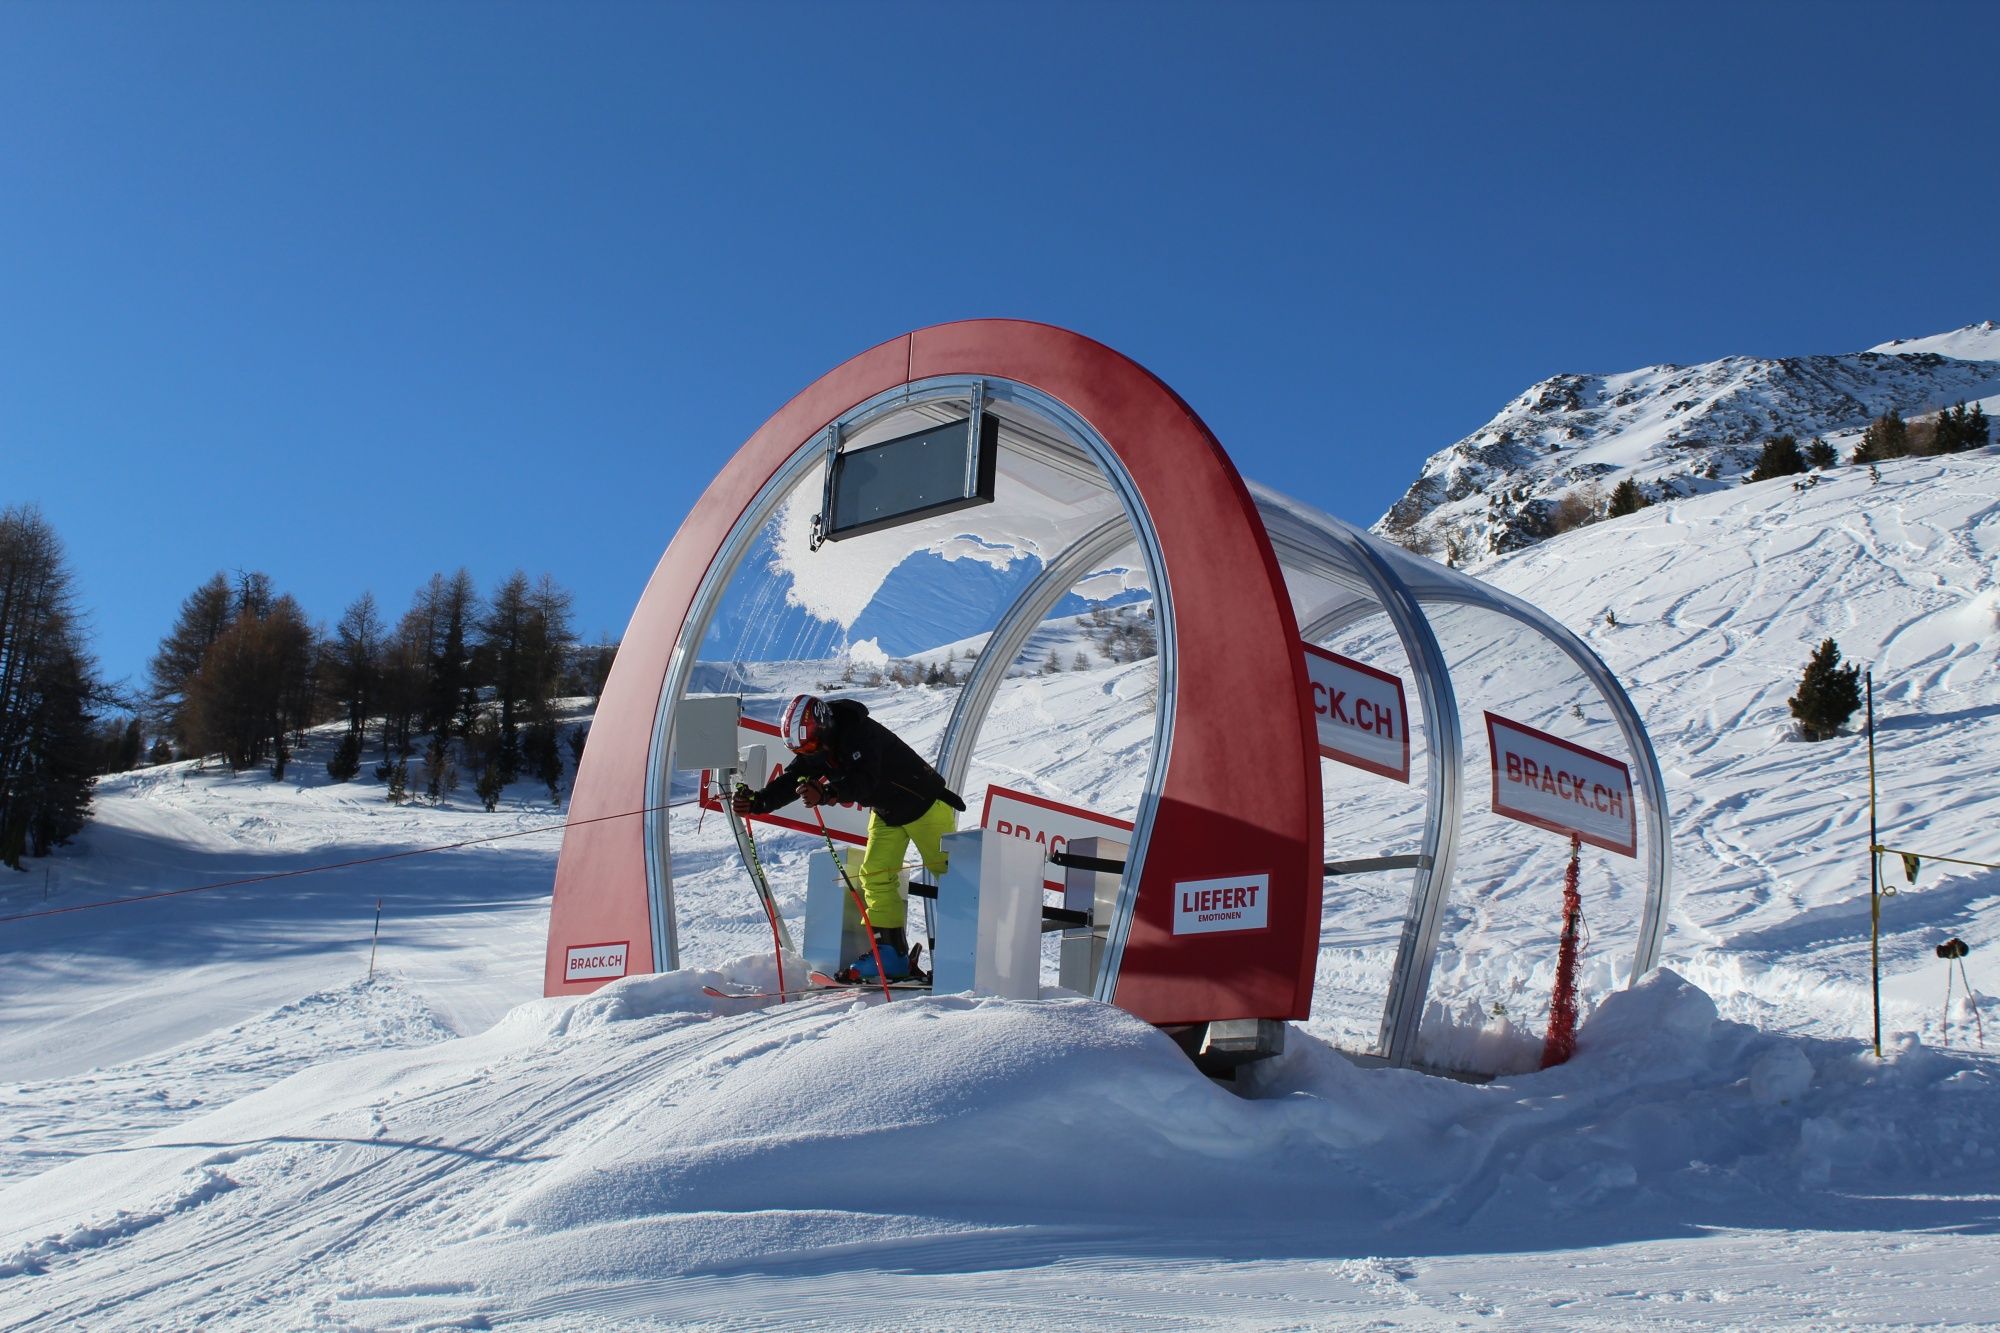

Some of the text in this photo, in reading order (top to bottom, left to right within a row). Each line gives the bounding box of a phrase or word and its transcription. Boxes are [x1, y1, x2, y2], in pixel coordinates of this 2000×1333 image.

[1506, 751, 1624, 819] BRACK.CH
[1183, 886, 1259, 913] LIEFERT
[1198, 911, 1242, 922] EMOTIONEN
[570, 955, 623, 970] BRACK.CH
